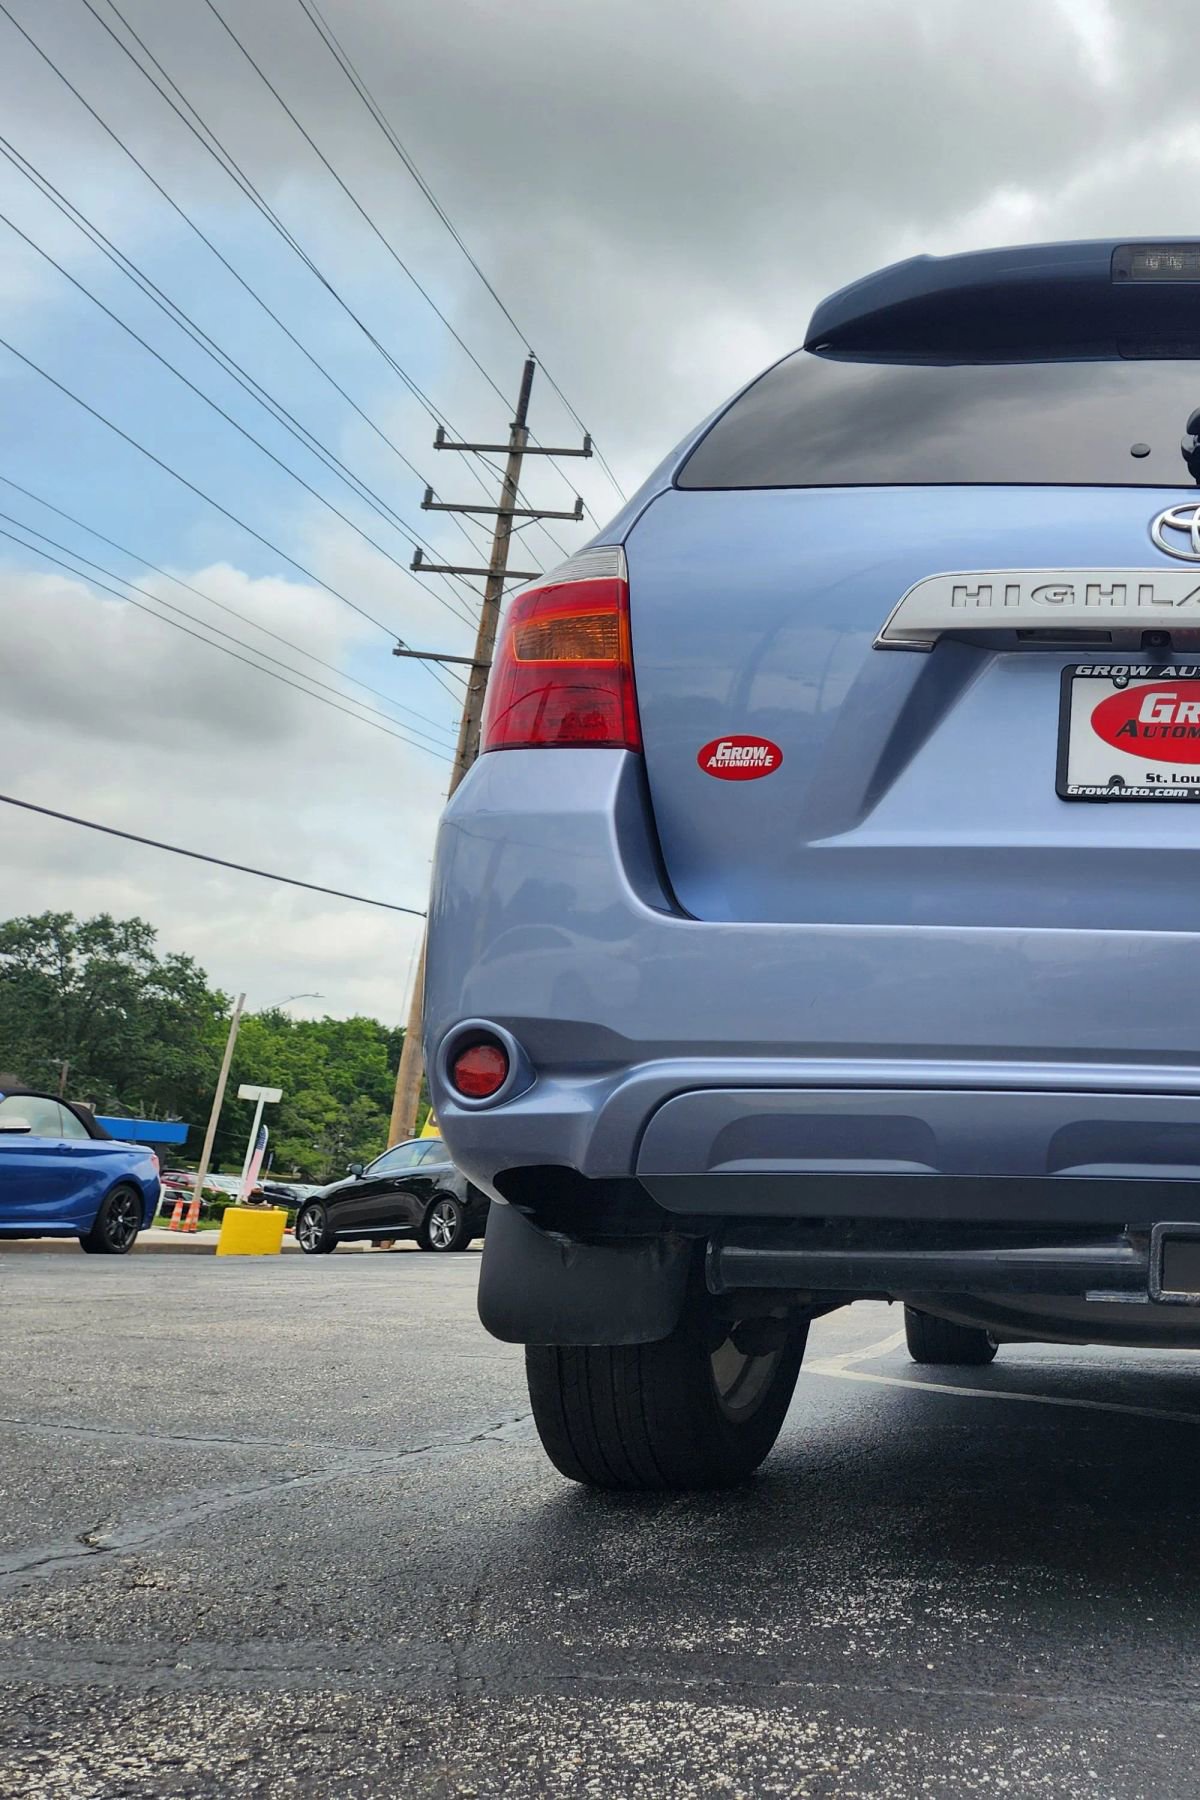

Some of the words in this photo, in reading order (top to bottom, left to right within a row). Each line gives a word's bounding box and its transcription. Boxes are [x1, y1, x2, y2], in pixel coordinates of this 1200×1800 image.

[1075, 665, 1152, 678] GROW
[715, 742, 769, 760] GROW
[706, 755, 775, 768] AUTOMOTIVE
[1146, 773, 1167, 783] St.
[1067, 785, 1189, 797] GrowAuto.com
